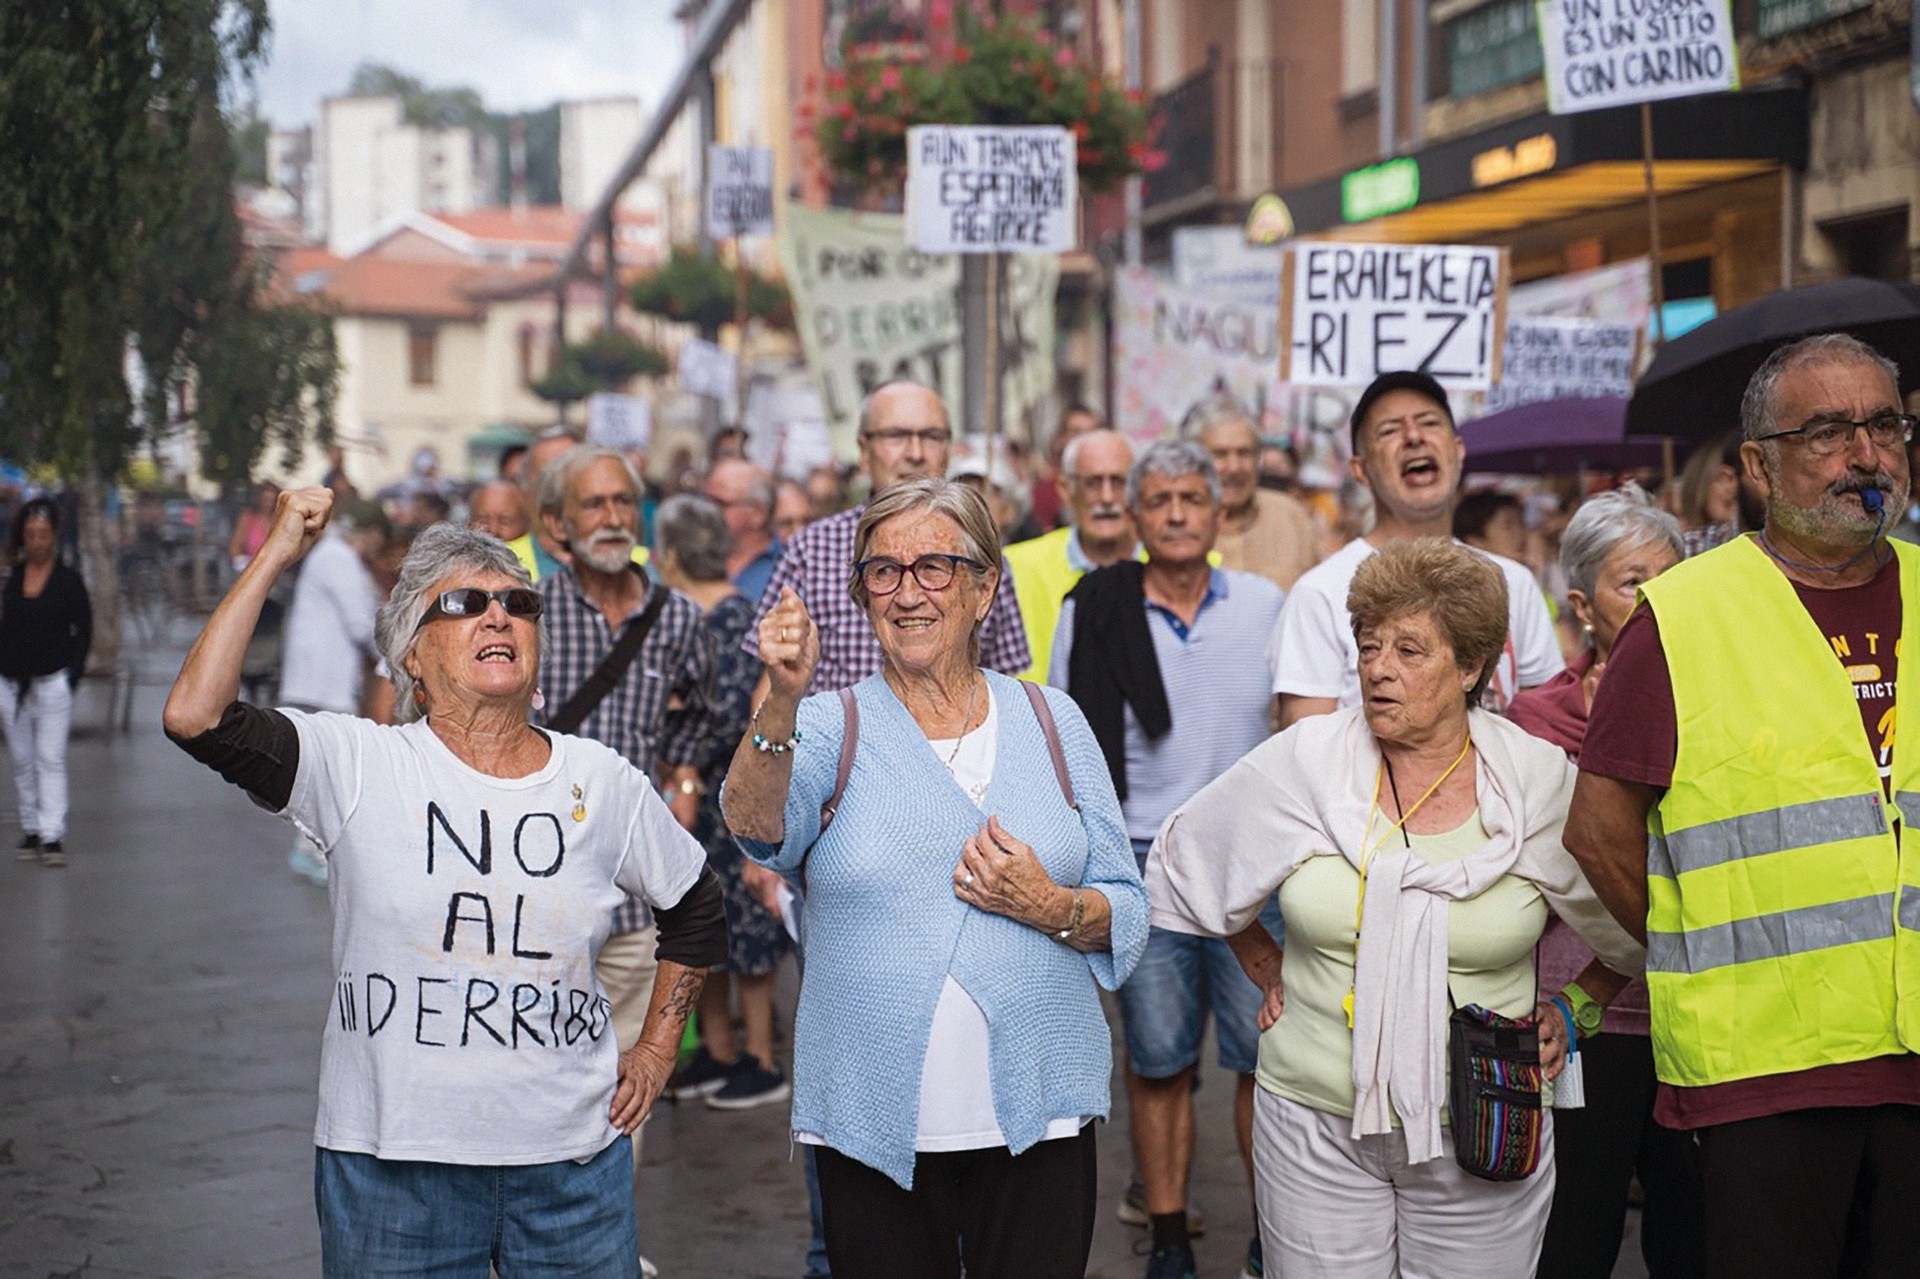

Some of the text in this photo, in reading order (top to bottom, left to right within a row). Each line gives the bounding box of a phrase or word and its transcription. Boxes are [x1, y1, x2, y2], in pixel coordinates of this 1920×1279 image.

[1563, 12, 1715, 56] ES UN SITIO
[1565, 57, 1615, 97] CON
[426, 801, 565, 878] NO
[442, 892, 553, 960] AL
